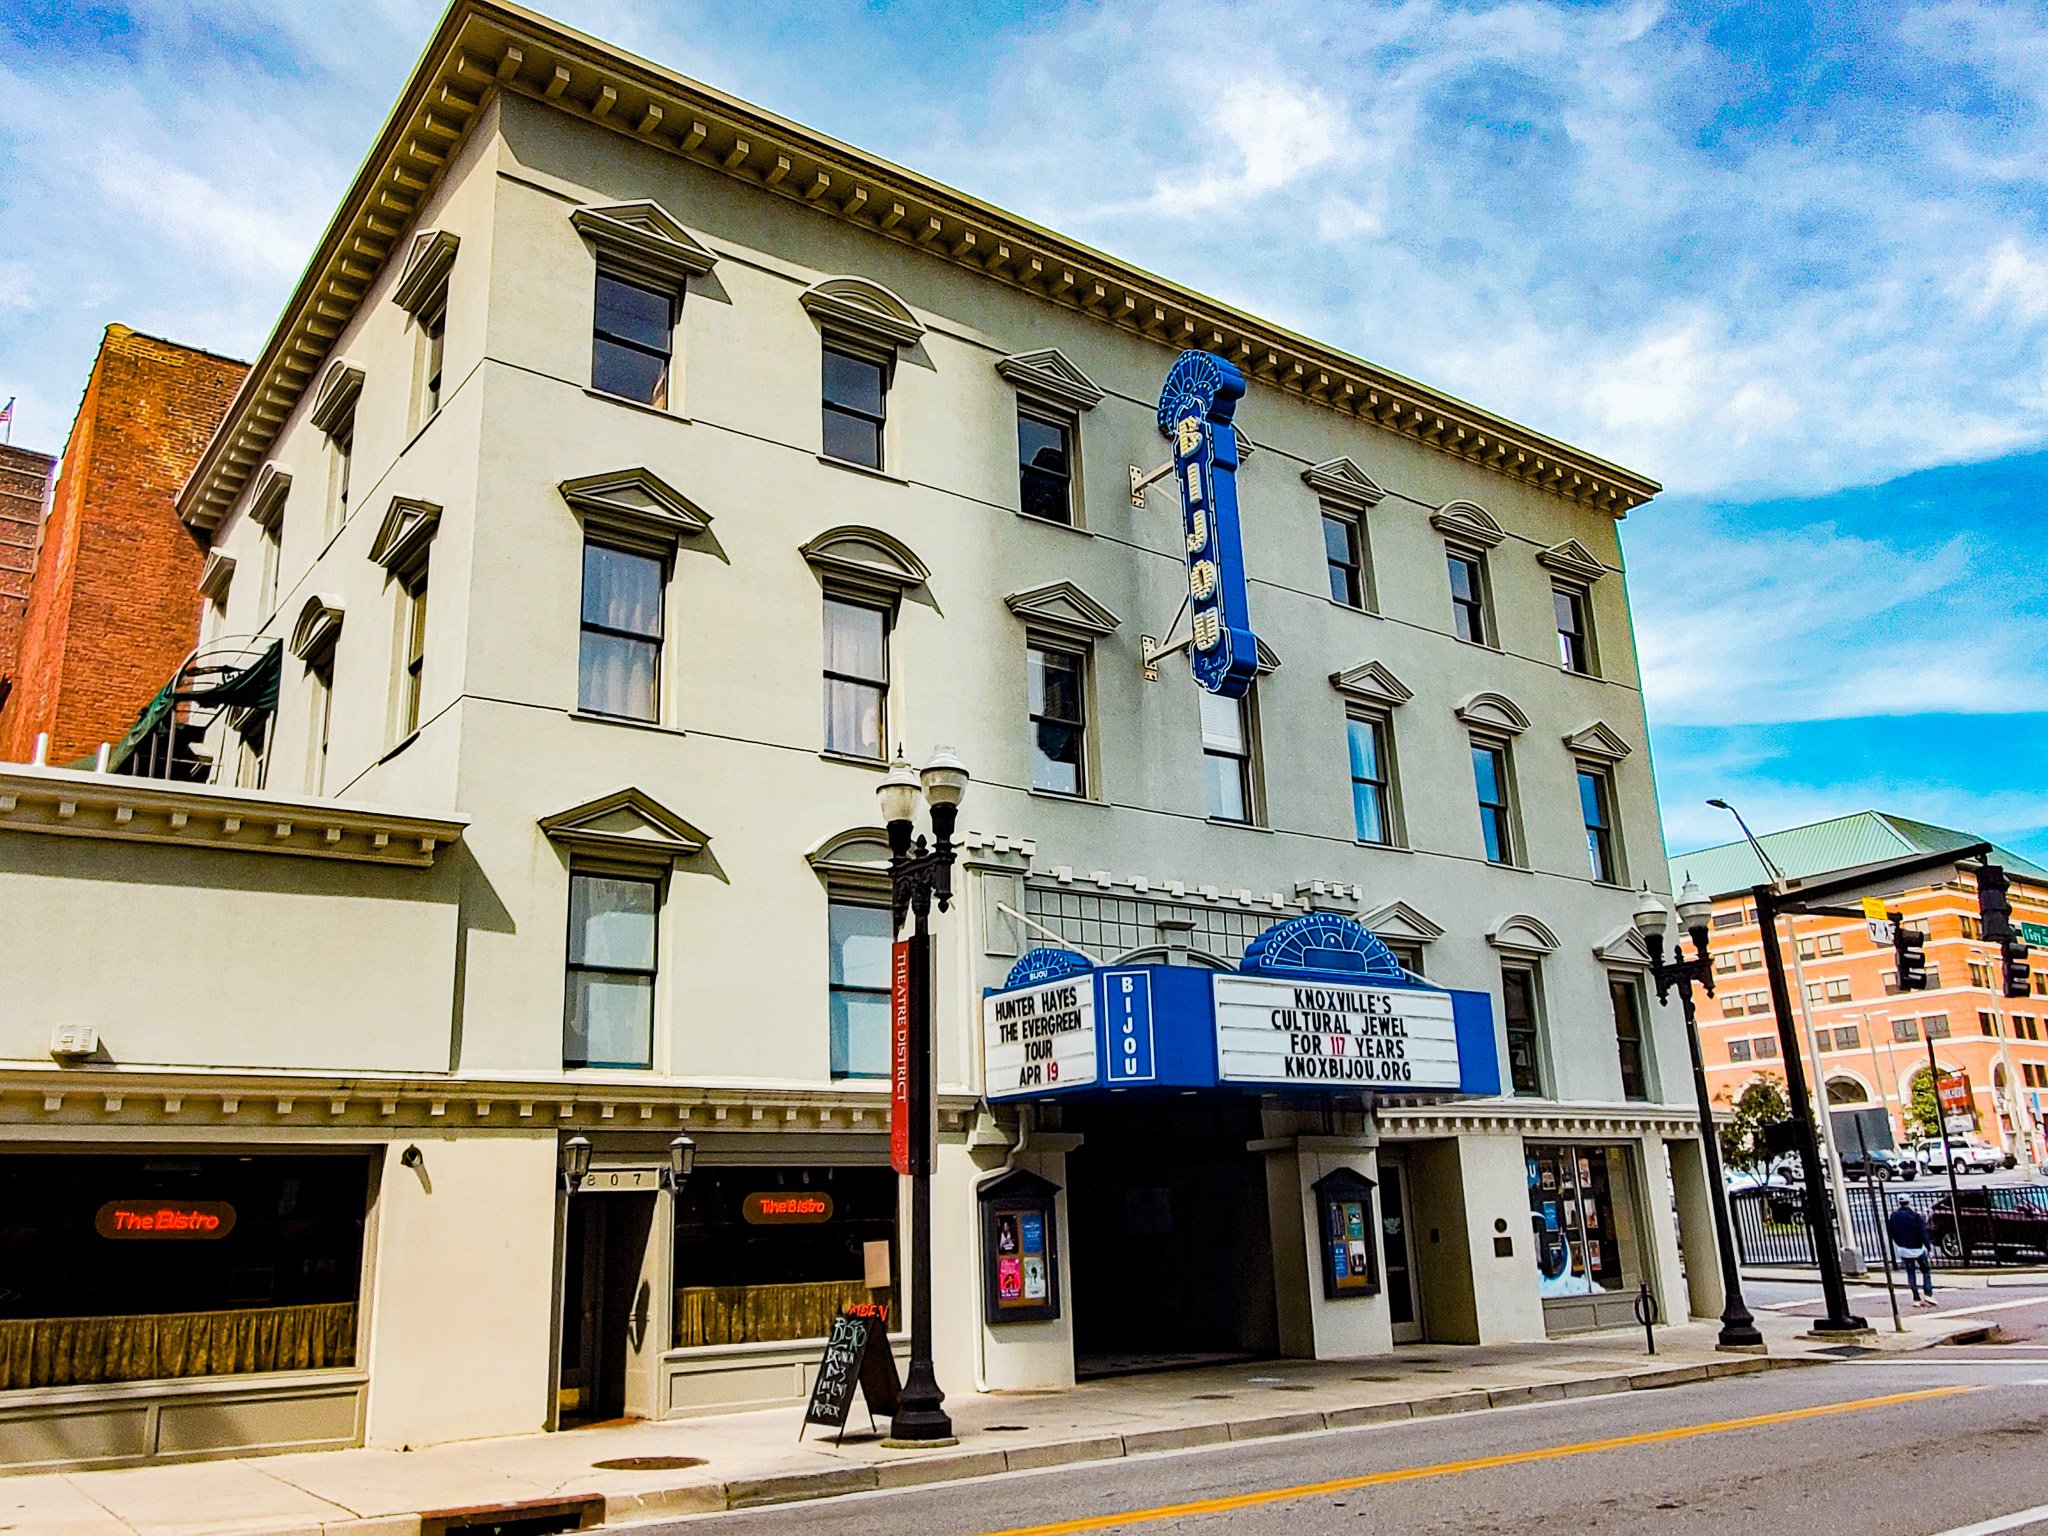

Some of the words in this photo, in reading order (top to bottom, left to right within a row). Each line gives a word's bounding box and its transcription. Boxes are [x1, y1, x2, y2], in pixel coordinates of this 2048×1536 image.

[1178, 415, 1220, 651] BIJOU
[896, 951, 906, 1026] THEATRE
[1029, 970, 1048, 981] BIJOU
[995, 996, 1035, 1022] HUNTER
[1041, 987, 1077, 1011] HAYES
[1293, 988, 1392, 1015] KNOXVILLE'S
[999, 1022, 1018, 1042] THE
[1022, 1010, 1081, 1040] EVERGREEN
[1121, 976, 1137, 1075] BIJOU
[1271, 1009, 1351, 1035] CULTURAL
[1361, 1016, 1408, 1038] JEWEL
[1024, 1039, 1053, 1060] TOUR
[1290, 1033, 1321, 1055] FOR
[1330, 1036, 1345, 1056] 117
[1355, 1037, 1405, 1059] YEARS
[896, 1029, 906, 1103] DISTRICT
[1019, 1066, 1041, 1087] APR
[1046, 1062, 1059, 1081] 19
[1284, 1056, 1411, 1081] KNOXBIJOU.ORG
[587, 1173, 642, 1187] 807
[114, 1210, 154, 1230] The
[154, 1208, 220, 1231] Bistro
[760, 1199, 786, 1214] The
[787, 1199, 825, 1214] Bistro
